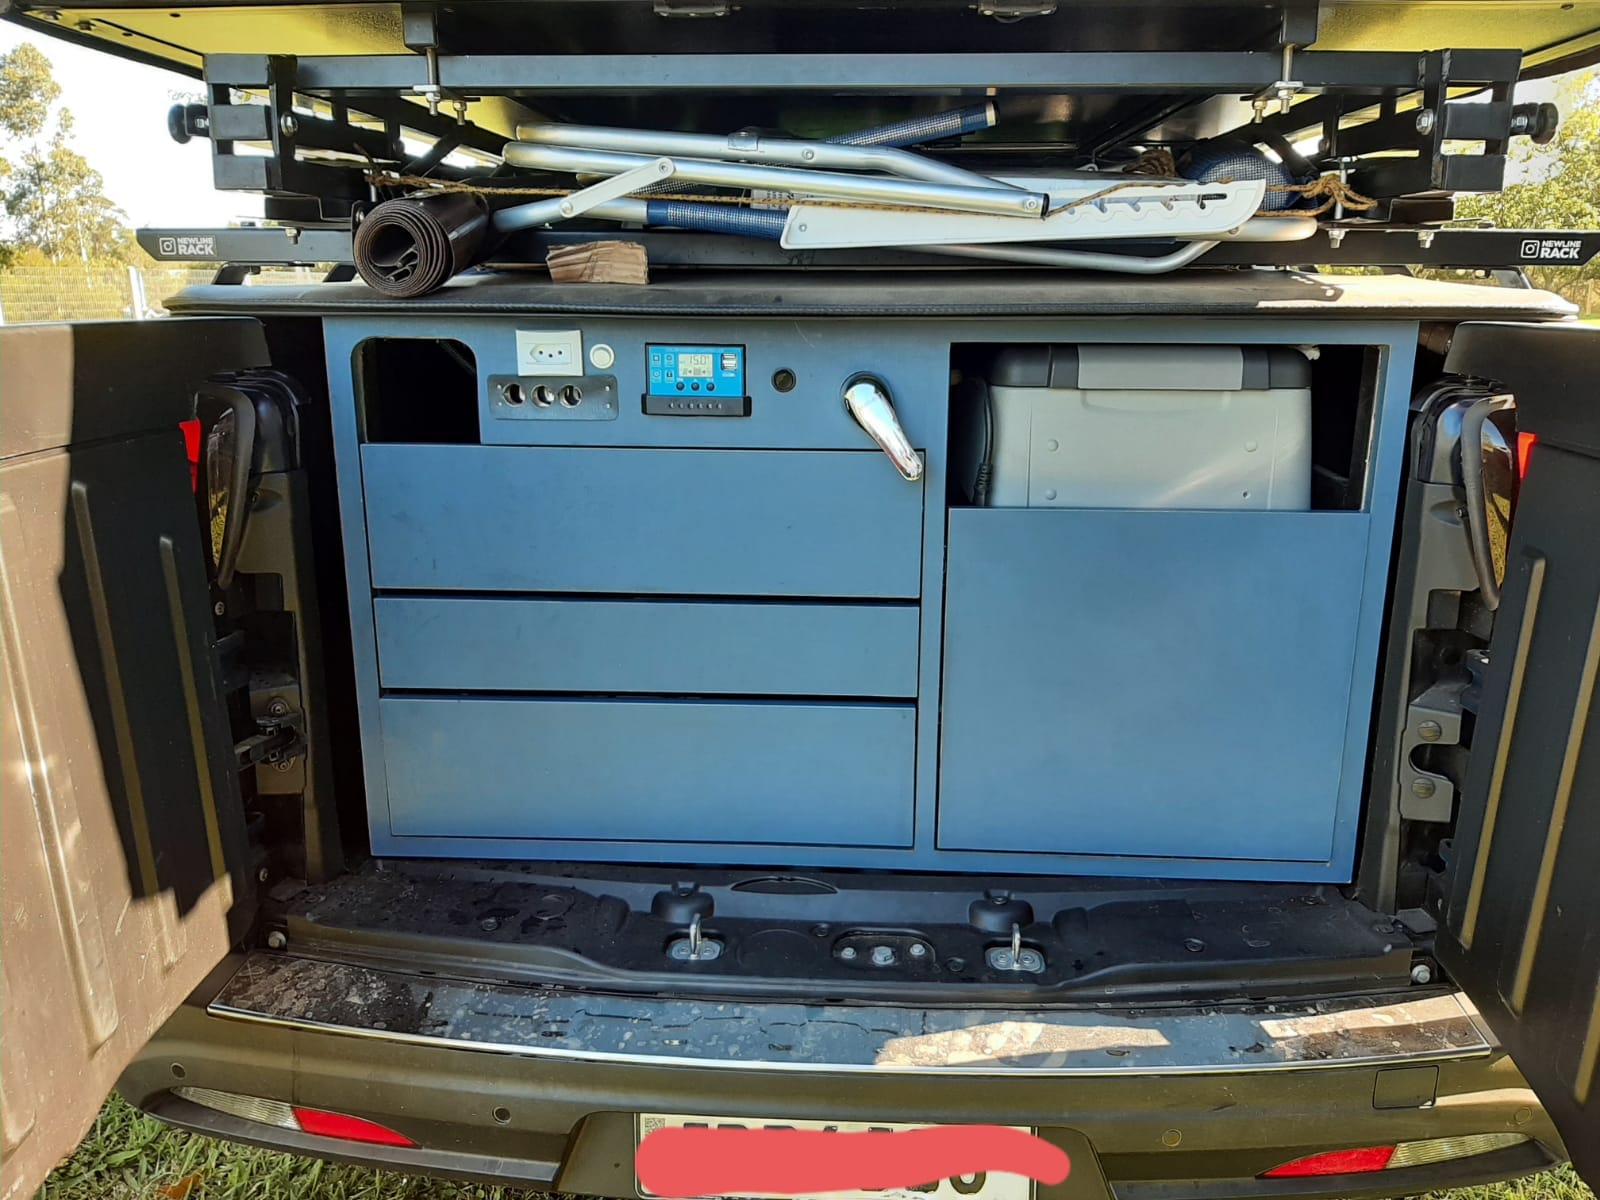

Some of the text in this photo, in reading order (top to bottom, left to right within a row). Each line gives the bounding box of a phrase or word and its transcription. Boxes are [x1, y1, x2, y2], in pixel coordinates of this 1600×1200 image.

[177, 237, 214, 245] NEWLINE
[1541, 240, 1582, 248] NEWLINE
[178, 244, 214, 255] RACK
[1540, 247, 1580, 258] RACK
